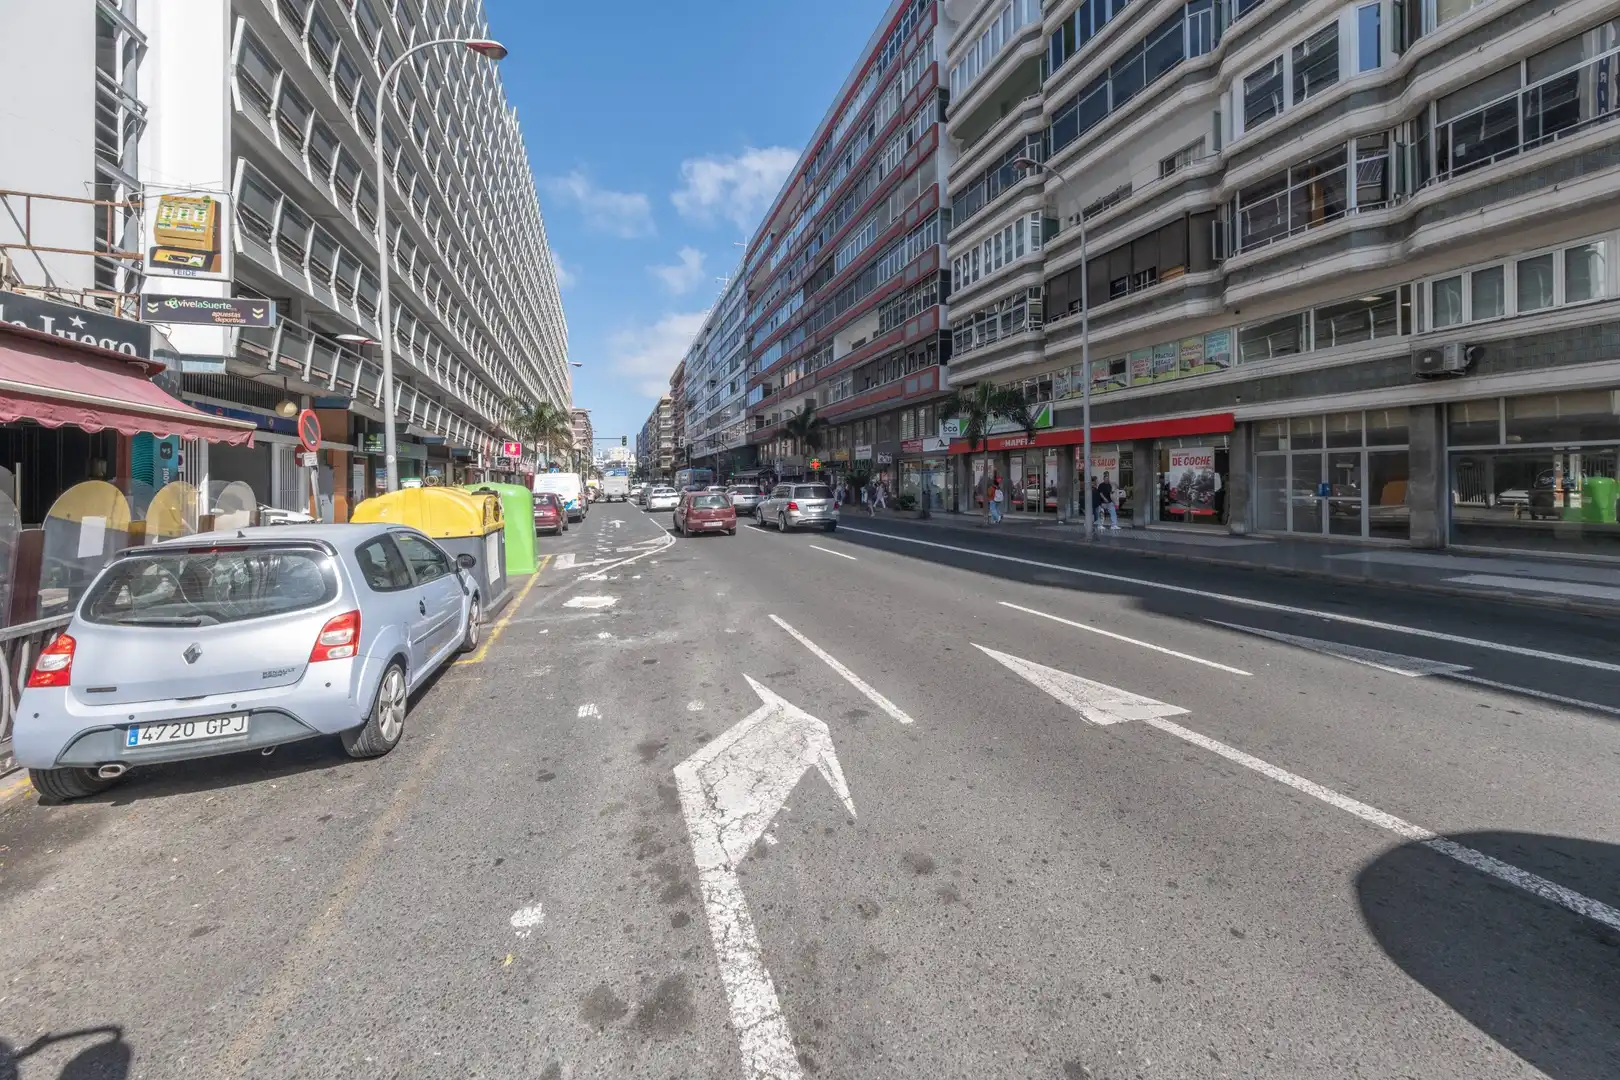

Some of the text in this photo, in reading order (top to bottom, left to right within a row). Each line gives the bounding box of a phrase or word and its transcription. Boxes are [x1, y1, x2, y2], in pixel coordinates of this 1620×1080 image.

[172, 269, 197, 278] TEIDE
[211, 311, 241, 320] apuestas
[214, 317, 247, 325] deportivas
[943, 425, 958, 433] eco
[1005, 437, 1036, 448] MAPFE
[1097, 457, 1117, 468] SALUD
[1172, 455, 1211, 466] DE COCHE
[142, 716, 245, 741] 4720 GPJ
